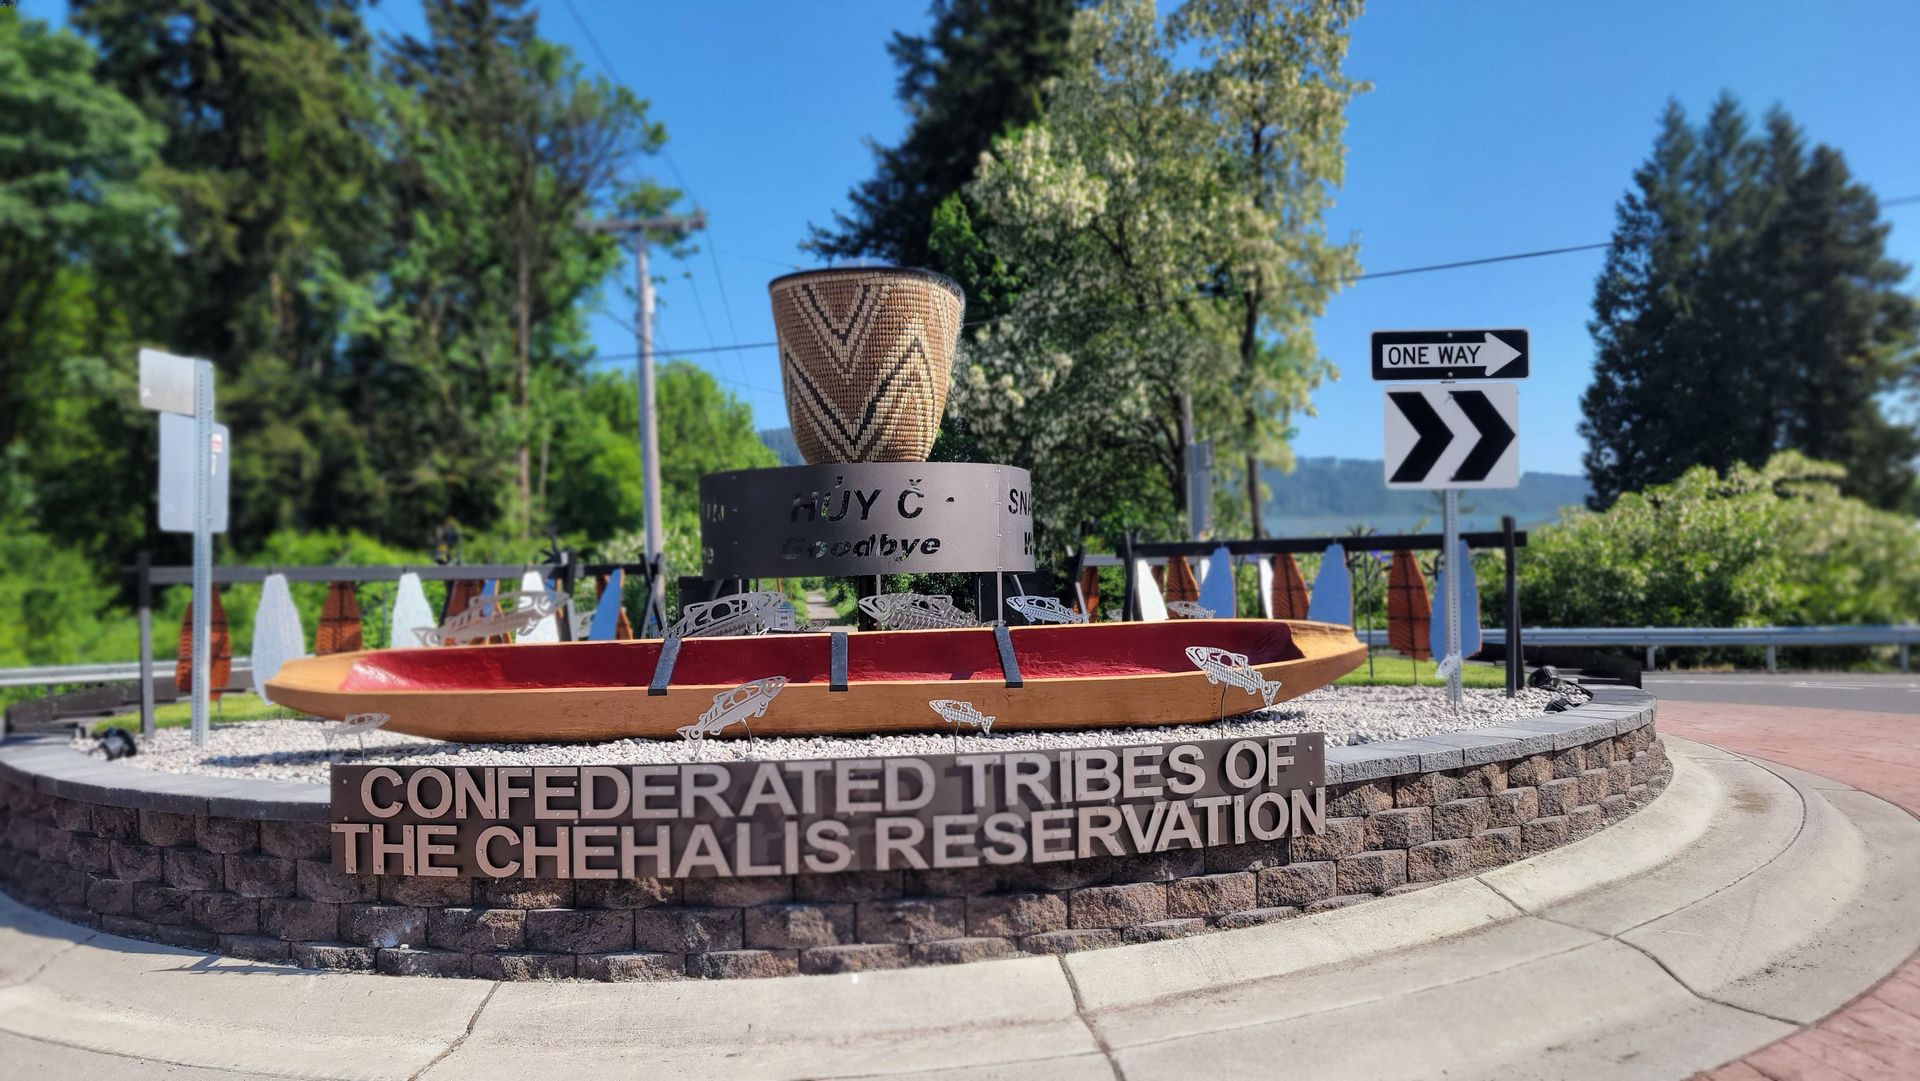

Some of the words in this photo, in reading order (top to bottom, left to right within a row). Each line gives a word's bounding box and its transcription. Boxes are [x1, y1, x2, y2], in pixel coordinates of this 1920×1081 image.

[1388, 346, 1429, 365] ONE
[1438, 345, 1481, 364] WAY
[780, 533, 941, 562] Goodbye
[360, 758, 936, 819] CONFEDERATED
[957, 744, 1206, 807] TRIBES
[1225, 737, 1297, 788] OF
[330, 823, 458, 877] THE
[475, 820, 852, 879] CHEHALIS
[875, 787, 1326, 870] RESERVATION
